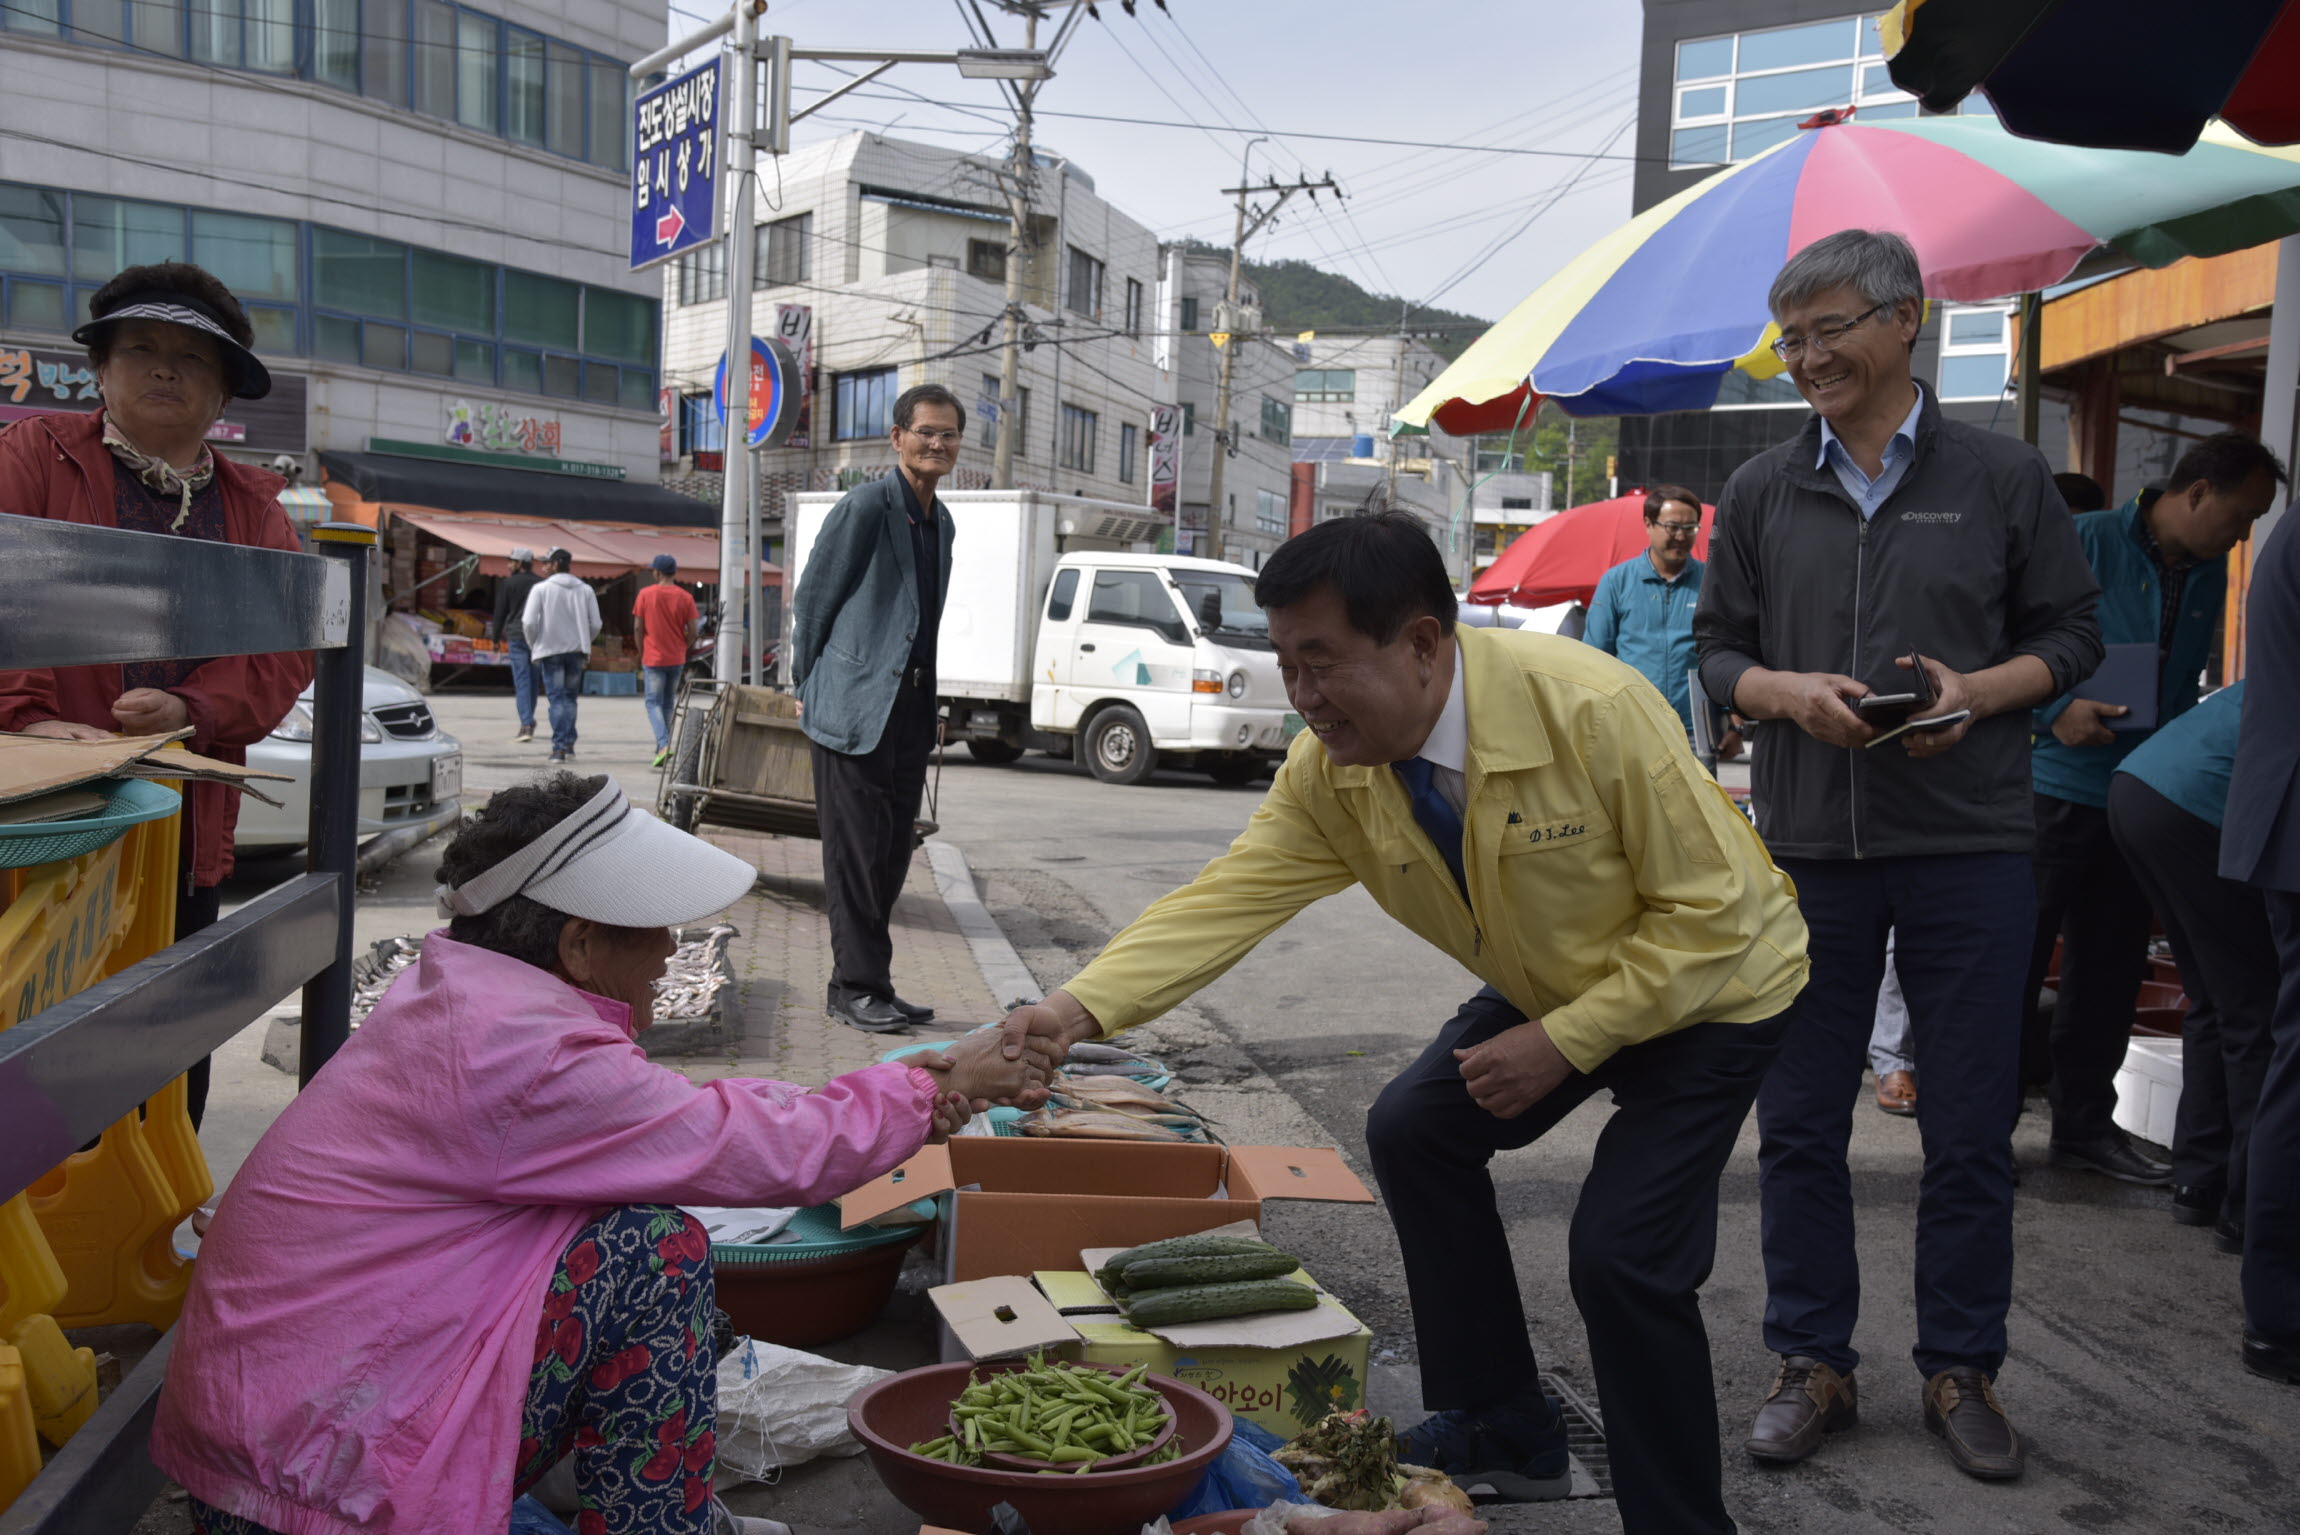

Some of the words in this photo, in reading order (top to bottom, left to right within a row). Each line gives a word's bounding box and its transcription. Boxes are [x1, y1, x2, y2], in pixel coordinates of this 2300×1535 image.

[638, 67, 715, 153] 진도상설시장
[36, 359, 101, 401] 방앗
[1152, 412, 1180, 482] 비너스
[1902, 511, 1962, 522] Discovery
